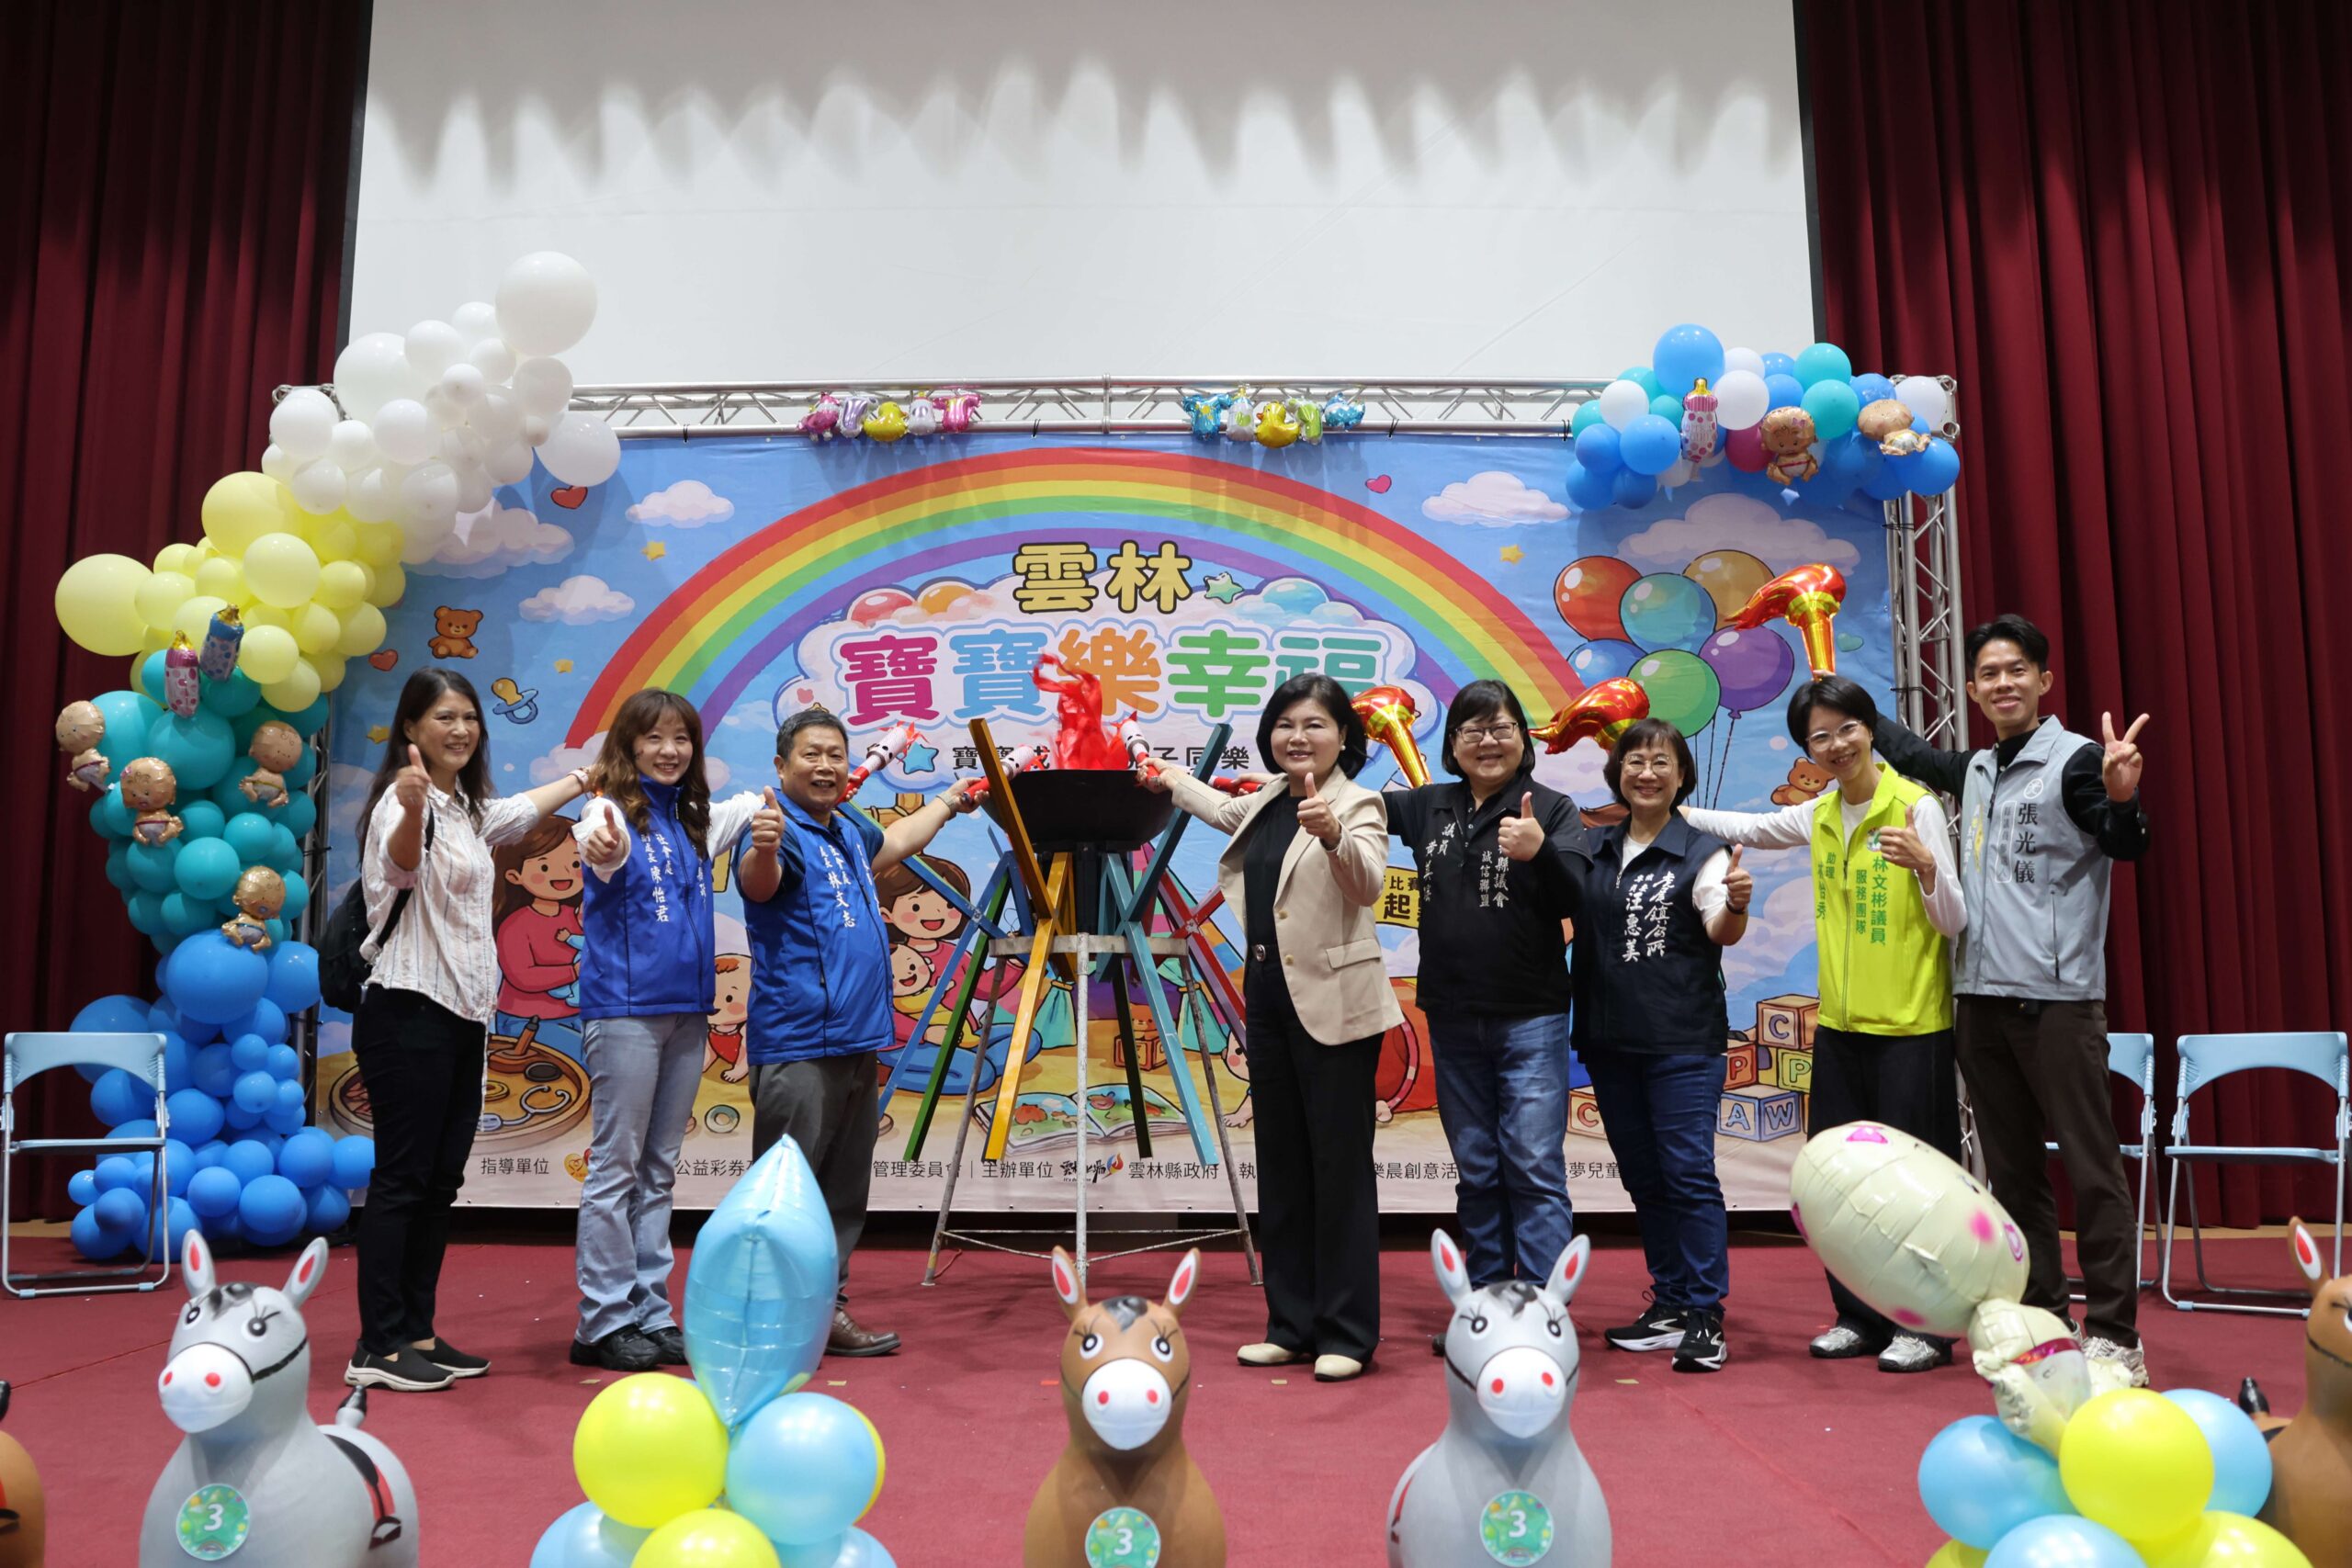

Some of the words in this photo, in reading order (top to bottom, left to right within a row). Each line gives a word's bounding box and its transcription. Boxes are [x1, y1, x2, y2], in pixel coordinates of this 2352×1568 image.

[1012, 540, 1192, 615] 雲林
[840, 628, 1381, 727] 寶寶樂幸福
[2014, 802, 2039, 884] 張光儀
[1479, 851, 1492, 908] 誠信聯盟
[1856, 869, 1868, 934] 服務團隊
[1871, 856, 1889, 946] 林文彬議員
[1622, 891, 1644, 962] 汪惠美
[1768, 1013, 1790, 1040] C
[1729, 1055, 1747, 1080] P
[1789, 1057, 1812, 1083] P
[1577, 1101, 1600, 1128] C
[1725, 1102, 1750, 1131] A
[1766, 1101, 1793, 1131] W
[481, 1157, 549, 1176] 指導單位
[981, 1160, 1054, 1179] 主辦單位
[1128, 1161, 1219, 1179] 雲林縣政府
[1563, 1161, 1622, 1179] 夢兒童
[203, 1503, 224, 1532] 3
[1508, 1509, 1527, 1538] 3
[1114, 1527, 1134, 1556] 3
